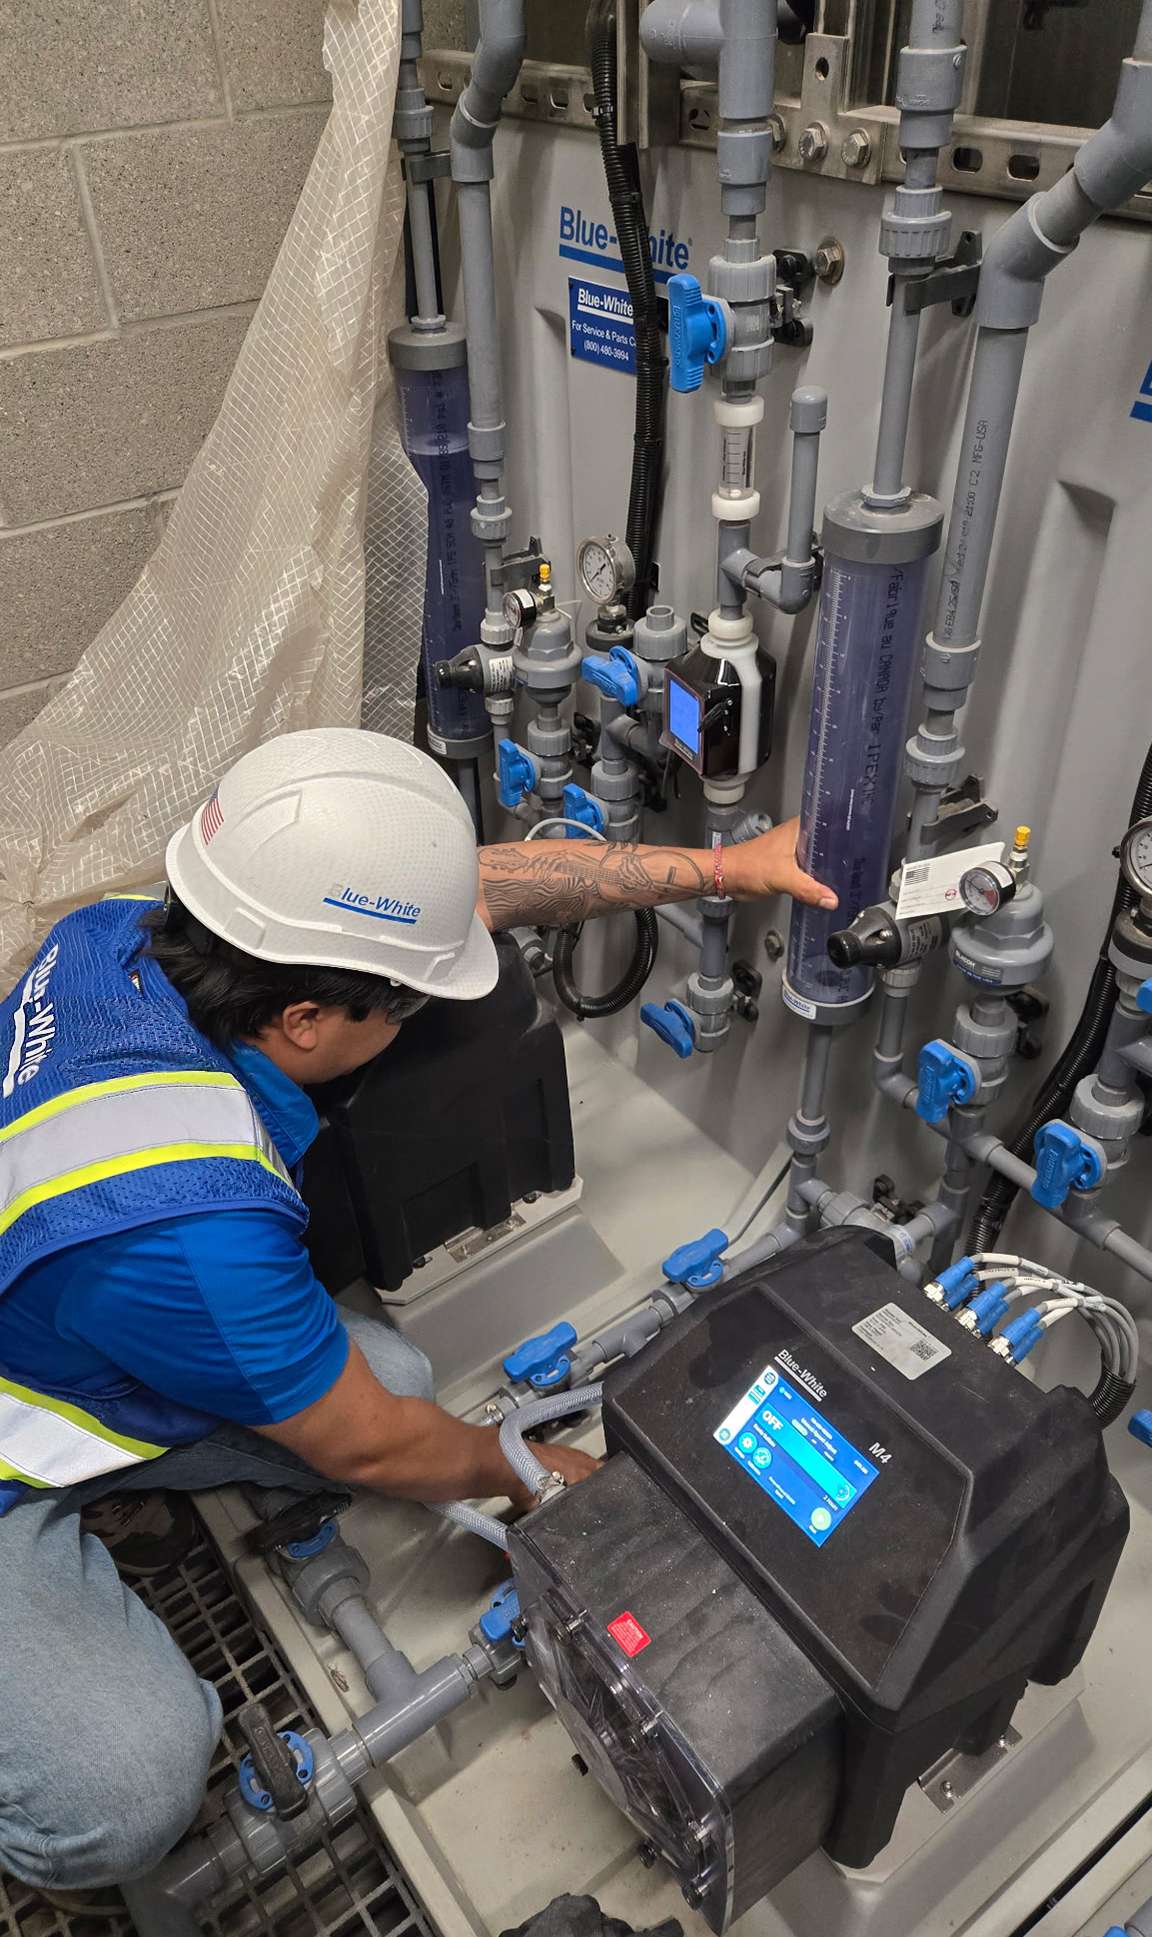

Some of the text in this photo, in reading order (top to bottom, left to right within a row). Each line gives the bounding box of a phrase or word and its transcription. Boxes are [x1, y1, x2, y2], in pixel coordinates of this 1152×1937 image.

[560, 206, 689, 270] Blue-ite
[578, 288, 634, 316] Blue-White
[572, 320, 582, 331] For
[582, 323, 605, 338] Service
[605, 329, 611, 340] &
[611, 332, 628, 345] Parts
[584, 340, 600, 355] (800)
[778, 1349, 828, 1398] Blue-White
[762, 1410, 784, 1431] OFF
[868, 1442, 892, 1464] M4
